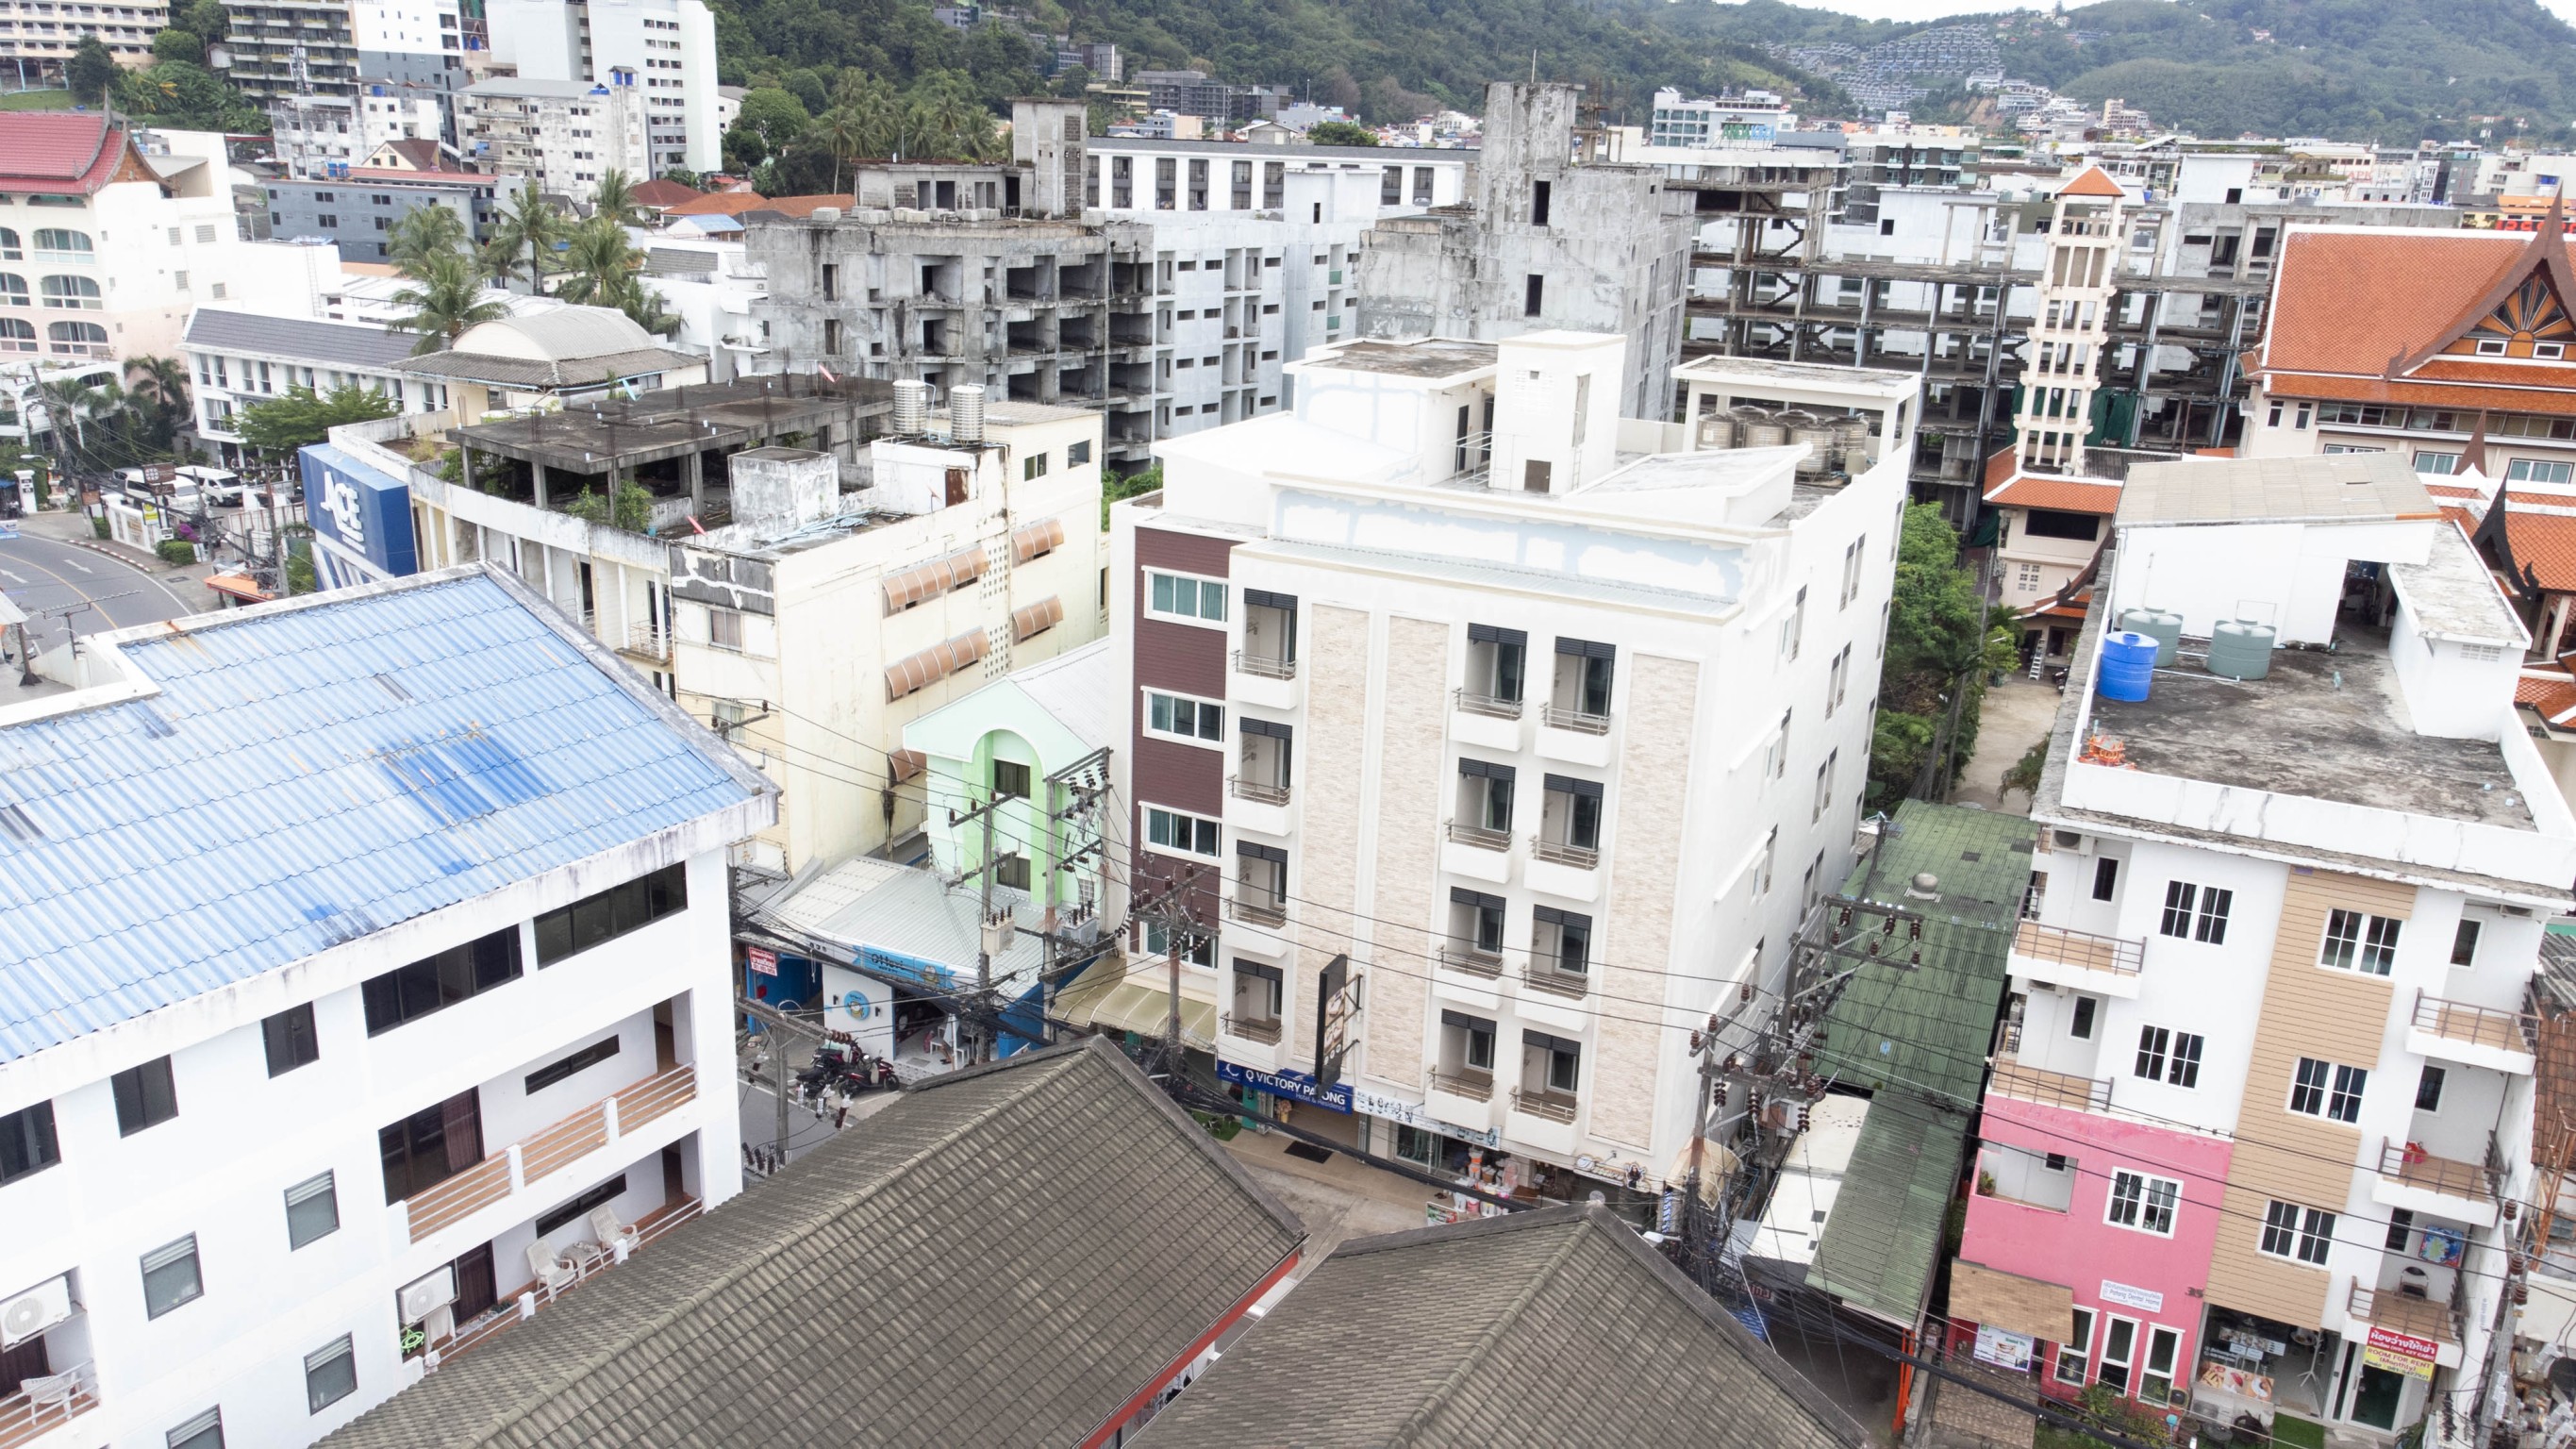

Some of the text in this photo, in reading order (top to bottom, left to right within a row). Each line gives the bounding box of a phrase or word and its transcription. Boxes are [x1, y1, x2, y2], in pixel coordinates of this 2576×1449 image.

[1245, 1070, 1255, 1082] Q
[1256, 1073, 1302, 1093] VICTORY
[1303, 1085, 1346, 1106] PAONG
[1295, 1092, 1310, 1102] Hotel
[2370, 1329, 2435, 1355] ห้องว่างให้เช่า
[2368, 1348, 2431, 1369] ROOM FOR RENT
[2379, 1357, 2417, 1372] (Monthly)
